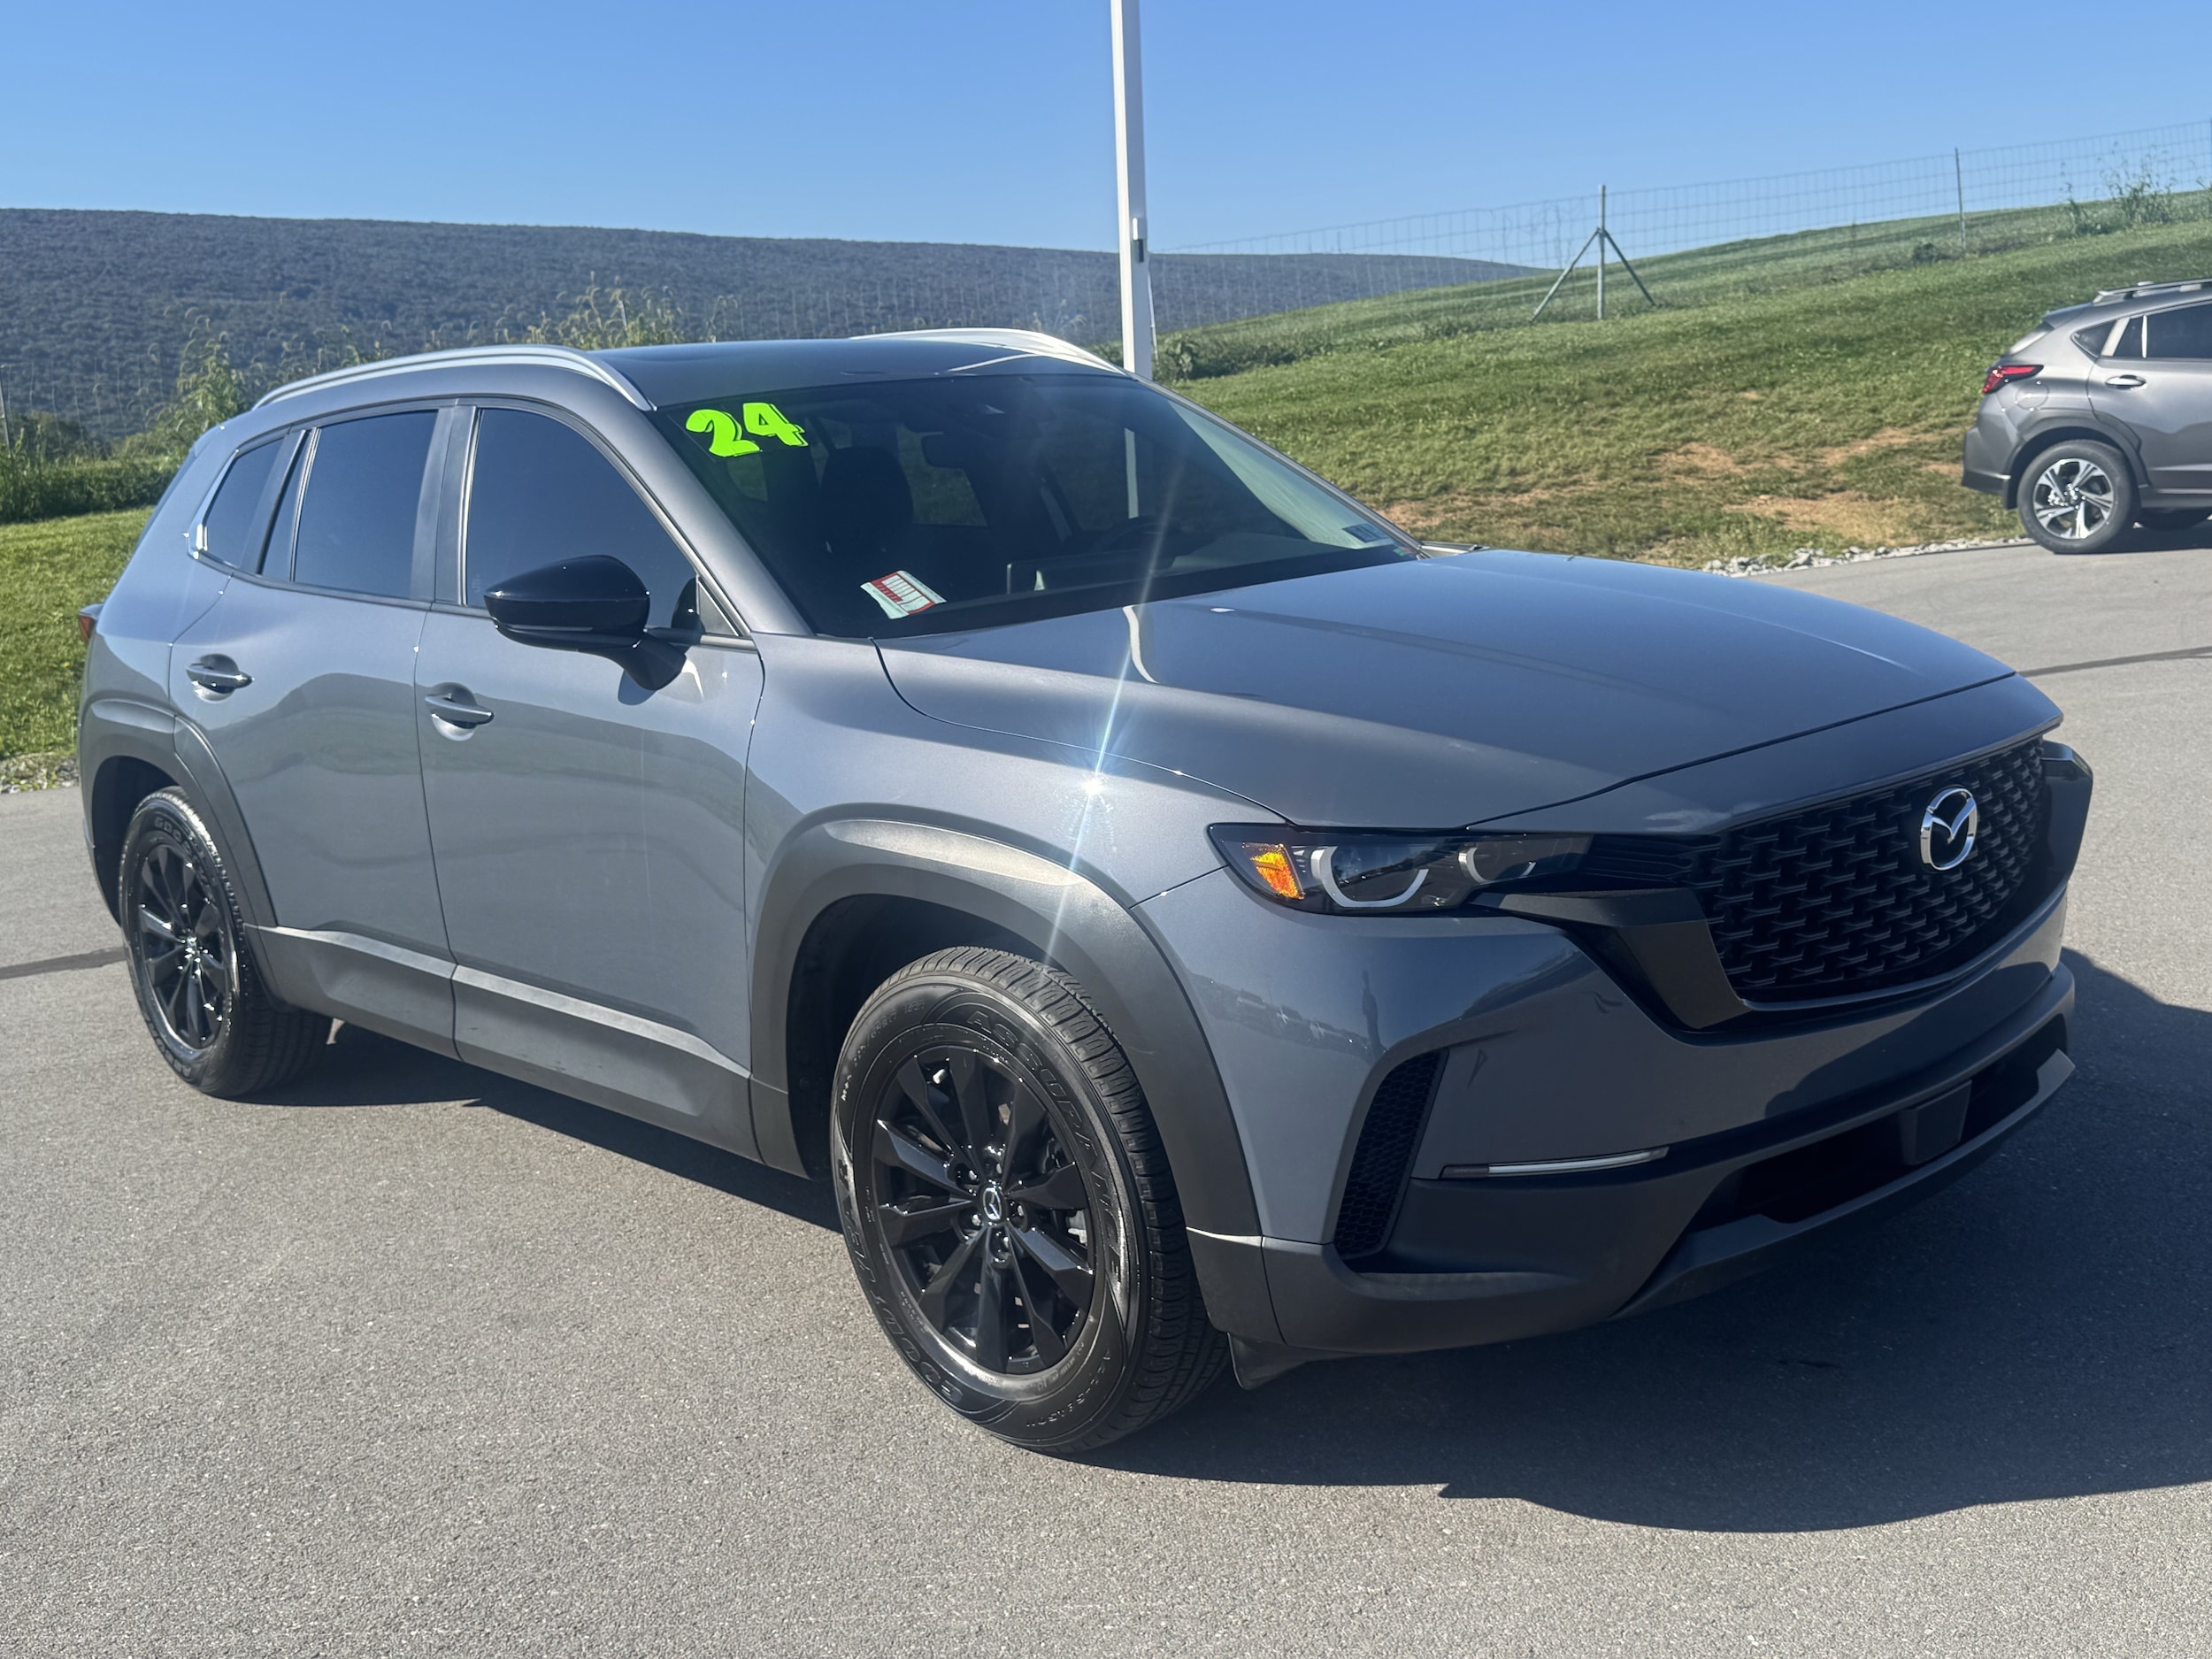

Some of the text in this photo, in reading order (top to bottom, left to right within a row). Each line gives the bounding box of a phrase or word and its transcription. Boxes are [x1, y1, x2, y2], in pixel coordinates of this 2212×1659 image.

[680, 402, 809, 457] 24
[967, 1010, 1123, 1286] ASSURANCE
[838, 1159, 964, 1403] GOODYEAR
